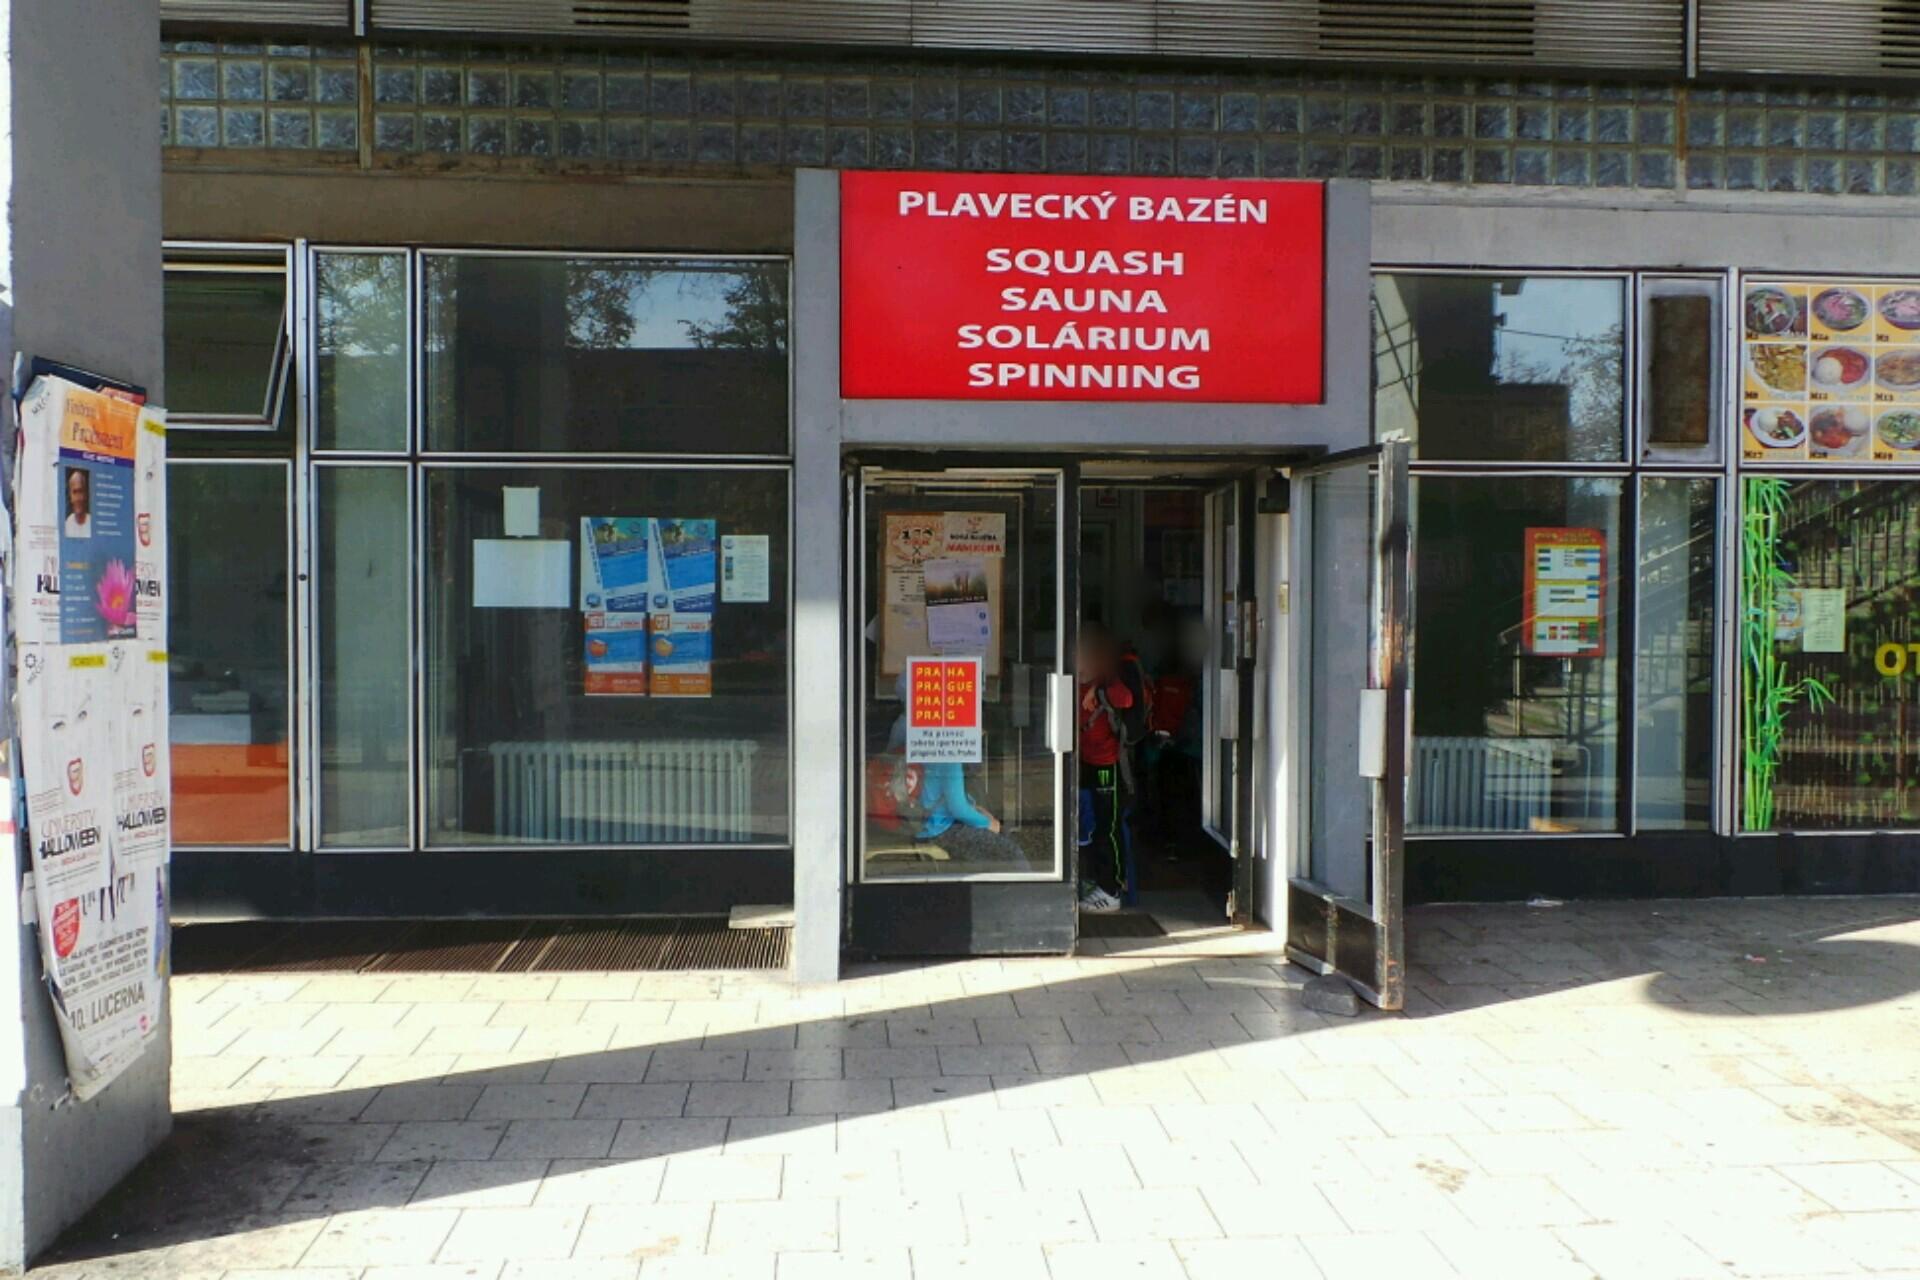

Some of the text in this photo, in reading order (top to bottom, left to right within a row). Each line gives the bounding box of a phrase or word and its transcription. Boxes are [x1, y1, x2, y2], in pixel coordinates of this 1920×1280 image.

[899, 190, 1267, 224] PLAVECKÝ BAZÉN
[986, 249, 1184, 276] SQUASH
[1001, 287, 1168, 313] SAUNA
[957, 322, 1210, 352] SOLÁRIUM
[968, 362, 1200, 389] SPINNING
[91, 981, 145, 1024] LUCERNA
